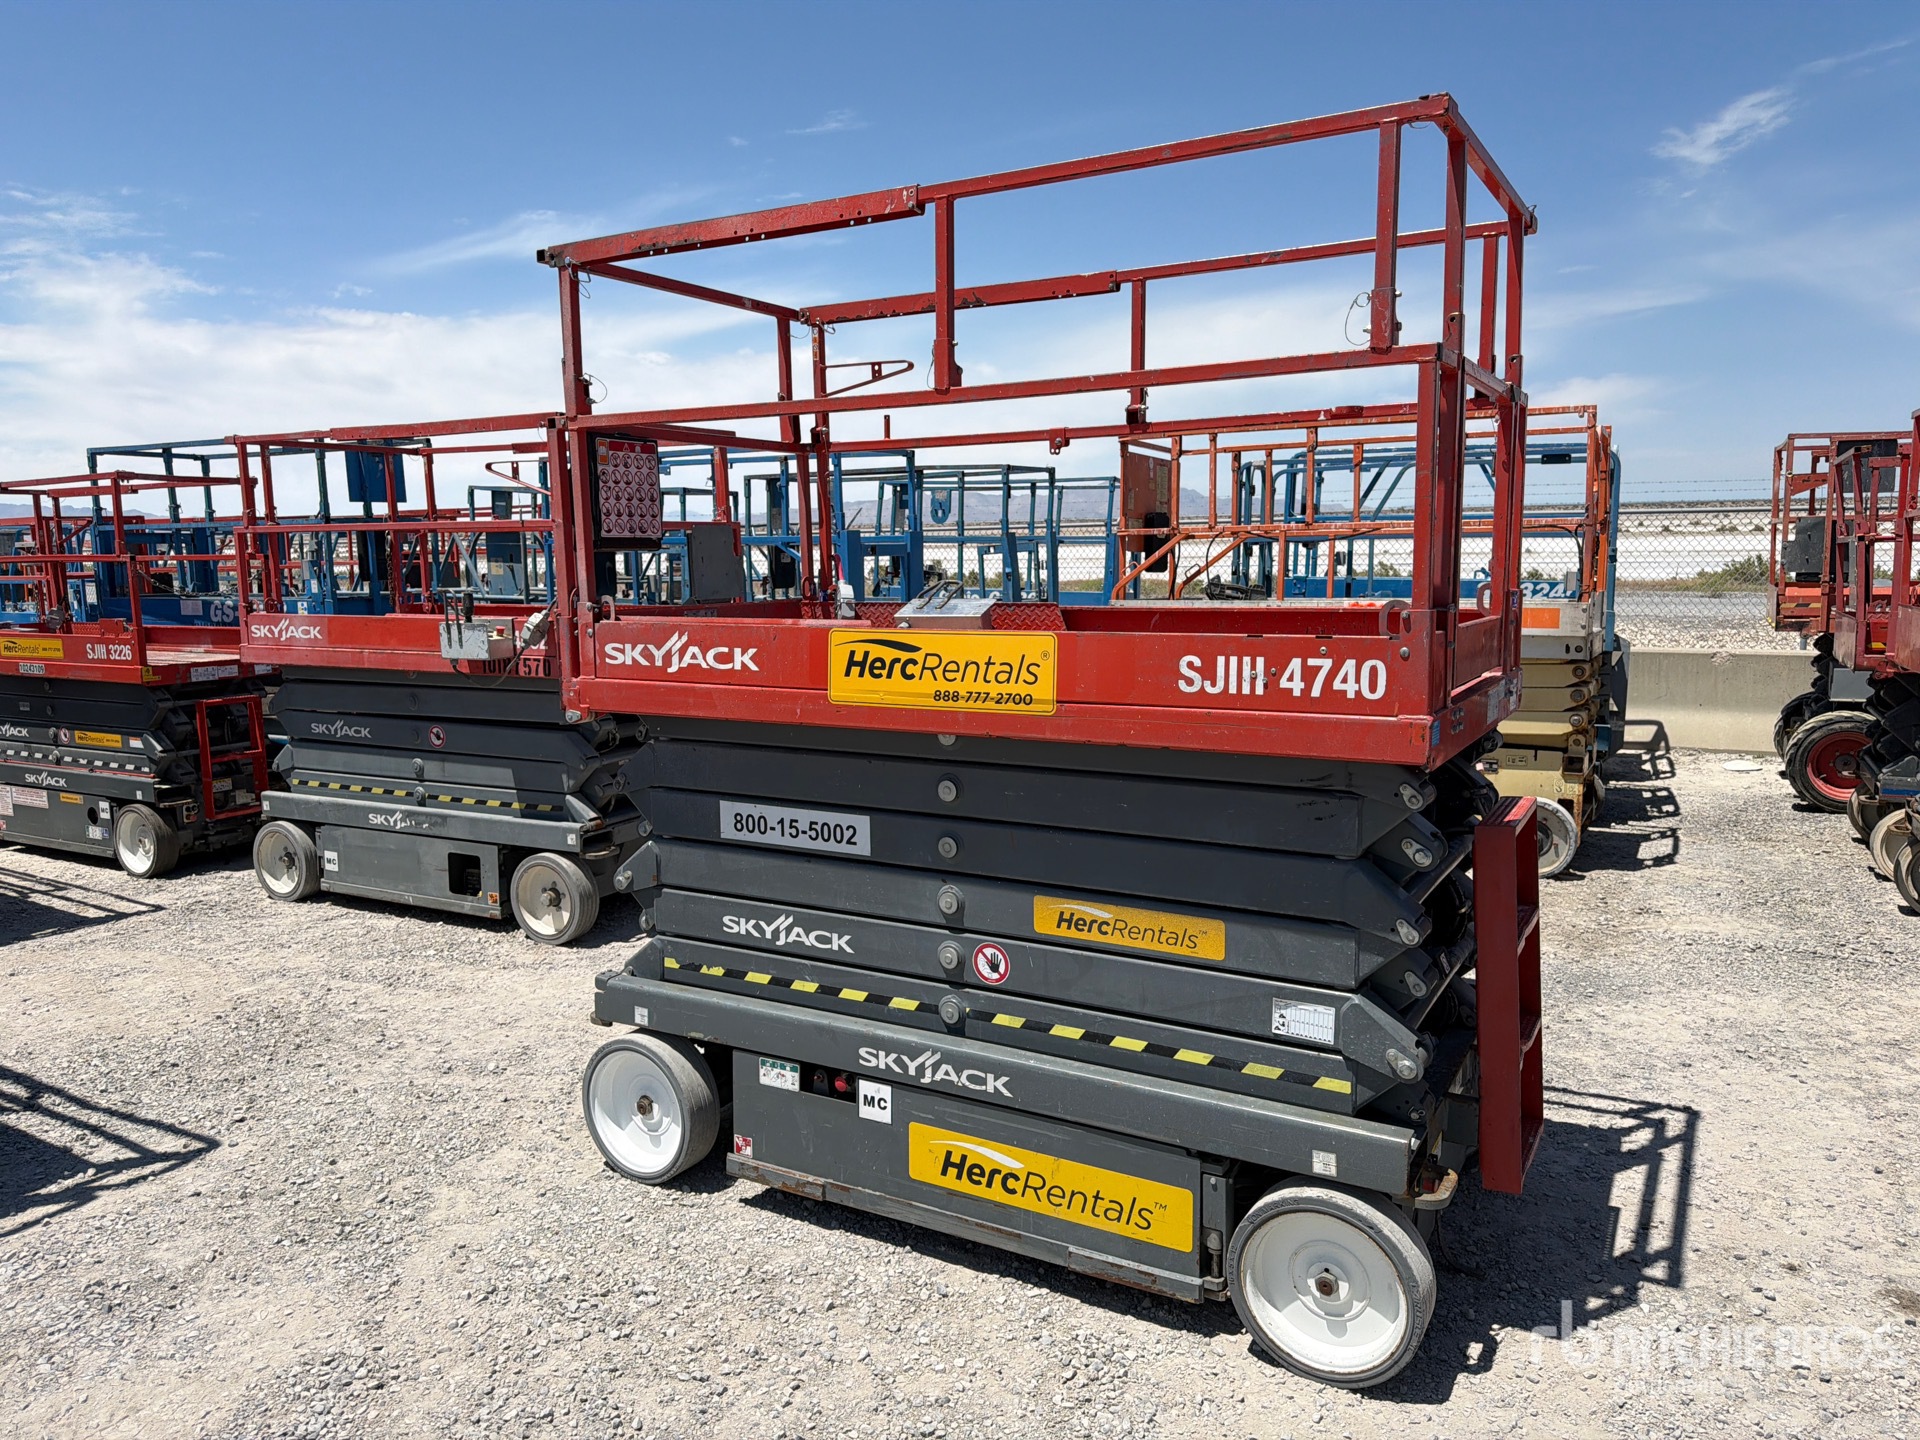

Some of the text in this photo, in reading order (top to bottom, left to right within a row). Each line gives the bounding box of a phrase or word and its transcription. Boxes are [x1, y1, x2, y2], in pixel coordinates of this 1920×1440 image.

[250, 618, 323, 641] SKYJACK
[109, 644, 133, 661] 3226
[604, 631, 760, 673] SKYJACK
[1279, 657, 1388, 701] 4740
[933, 689, 1034, 707] 888-777-2700
[310, 719, 373, 739] SKYJACK
[24, 771, 68, 788] SKYJACK
[733, 812, 858, 846] 800-15-5002
[326, 856, 337, 866] MC
[722, 912, 856, 954] SKYJACK
[858, 1046, 1014, 1099] SKYJACK
[863, 1094, 888, 1111] MC
